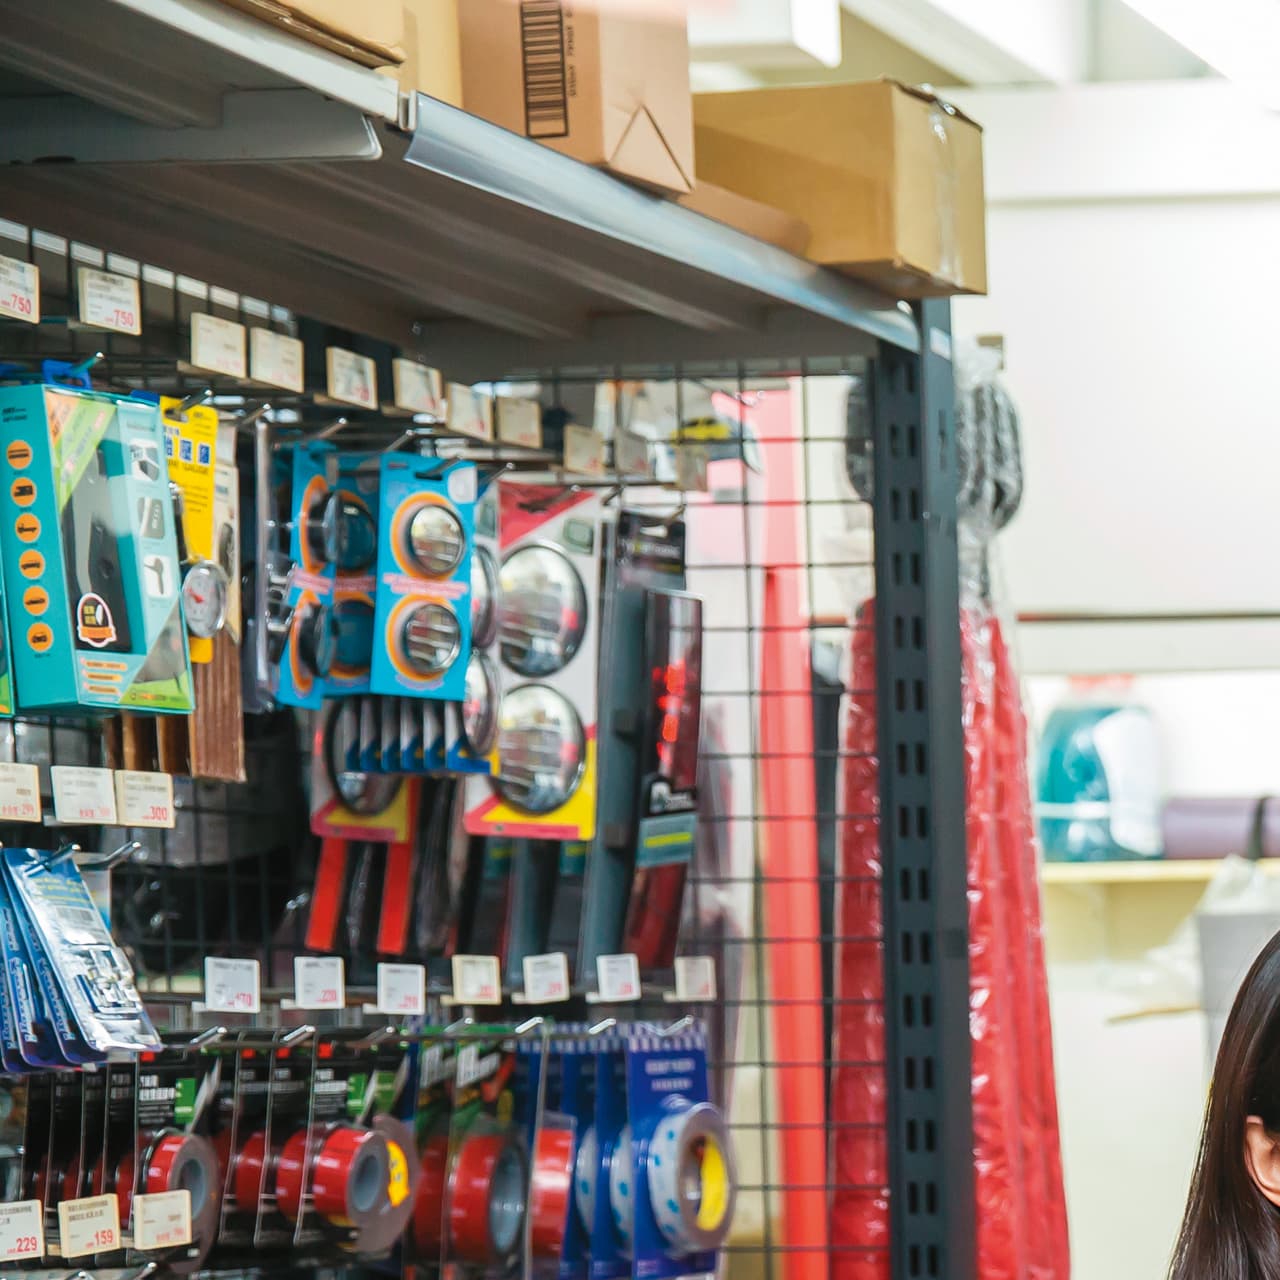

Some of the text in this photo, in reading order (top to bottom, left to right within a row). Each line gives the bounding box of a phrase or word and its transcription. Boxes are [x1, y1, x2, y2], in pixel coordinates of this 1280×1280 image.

[11, 294, 32, 315] 750
[113, 309, 134, 327] 750
[16, 1237, 38, 1252] 229
[94, 1229, 114, 1246] 159
